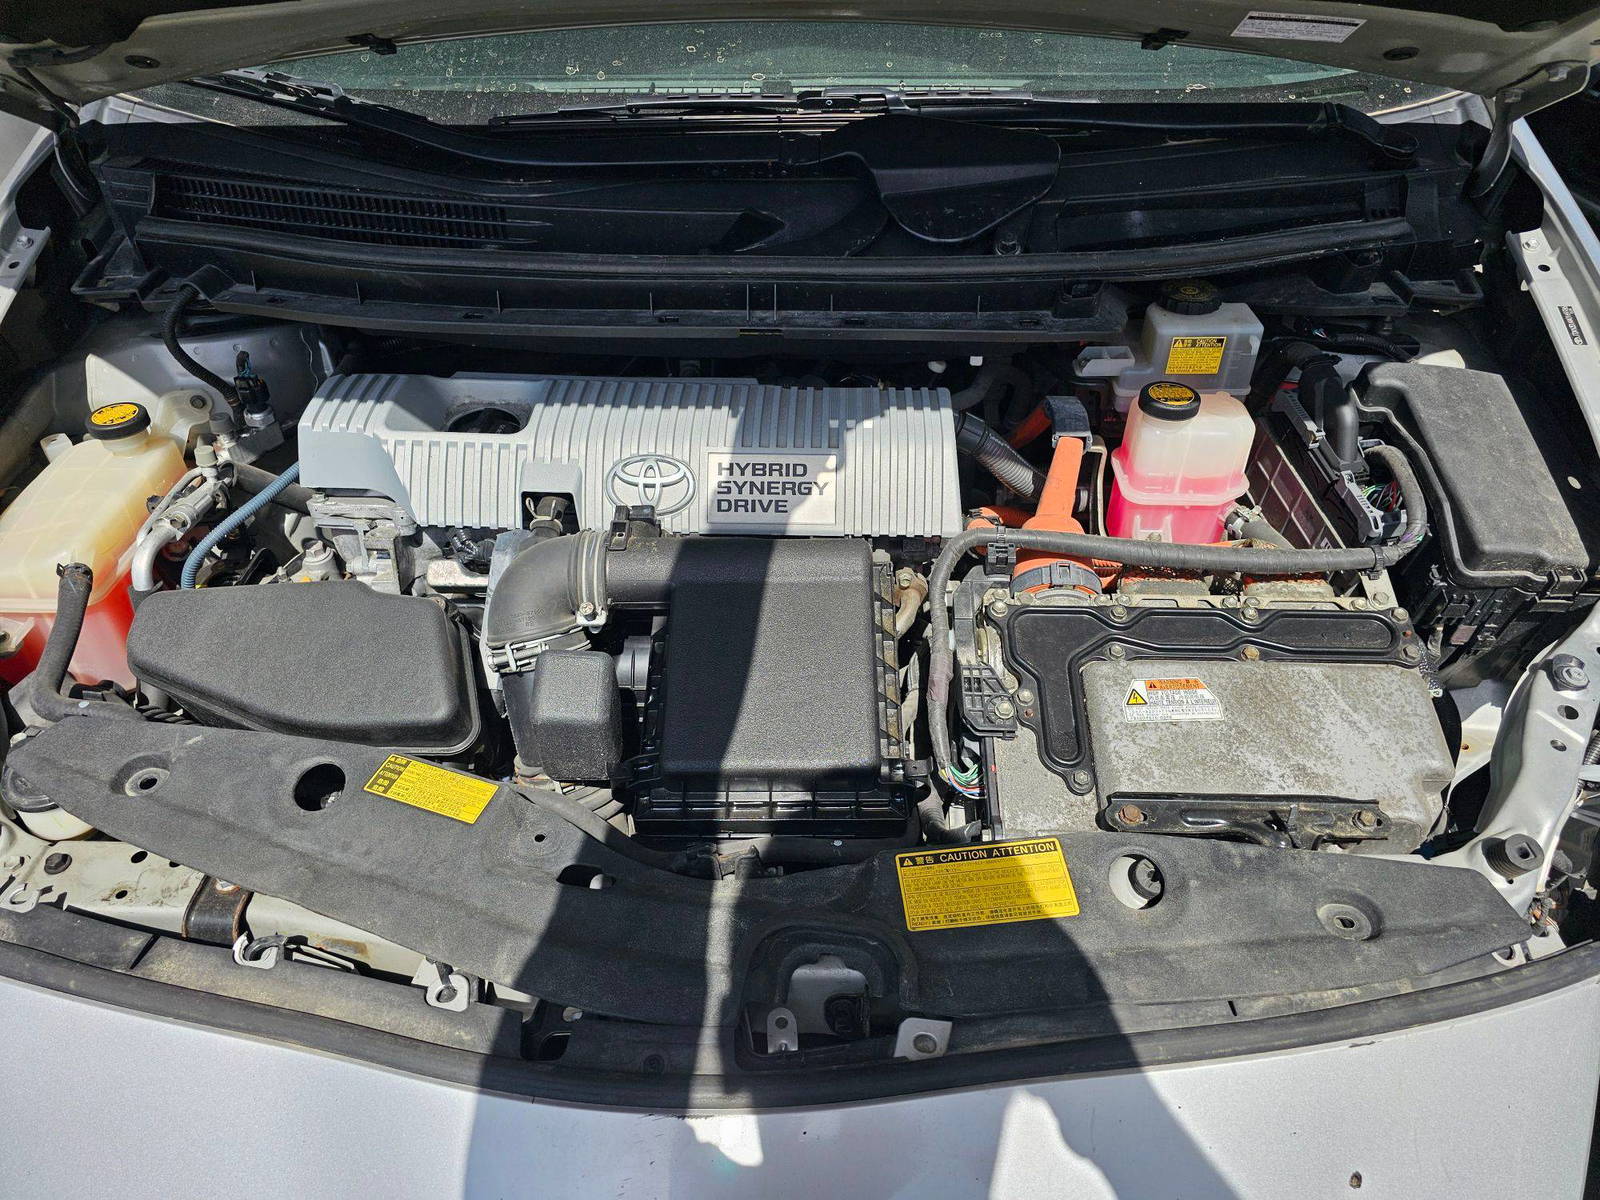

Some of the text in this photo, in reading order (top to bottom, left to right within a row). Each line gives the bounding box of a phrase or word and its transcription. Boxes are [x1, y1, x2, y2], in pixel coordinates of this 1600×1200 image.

[717, 462, 808, 477] HYBRID
[717, 481, 829, 496] SYNERGY
[717, 498, 789, 513] DRIVE
[939, 849, 988, 863] CAUTION
[992, 842, 1055, 857] ATTENTION
